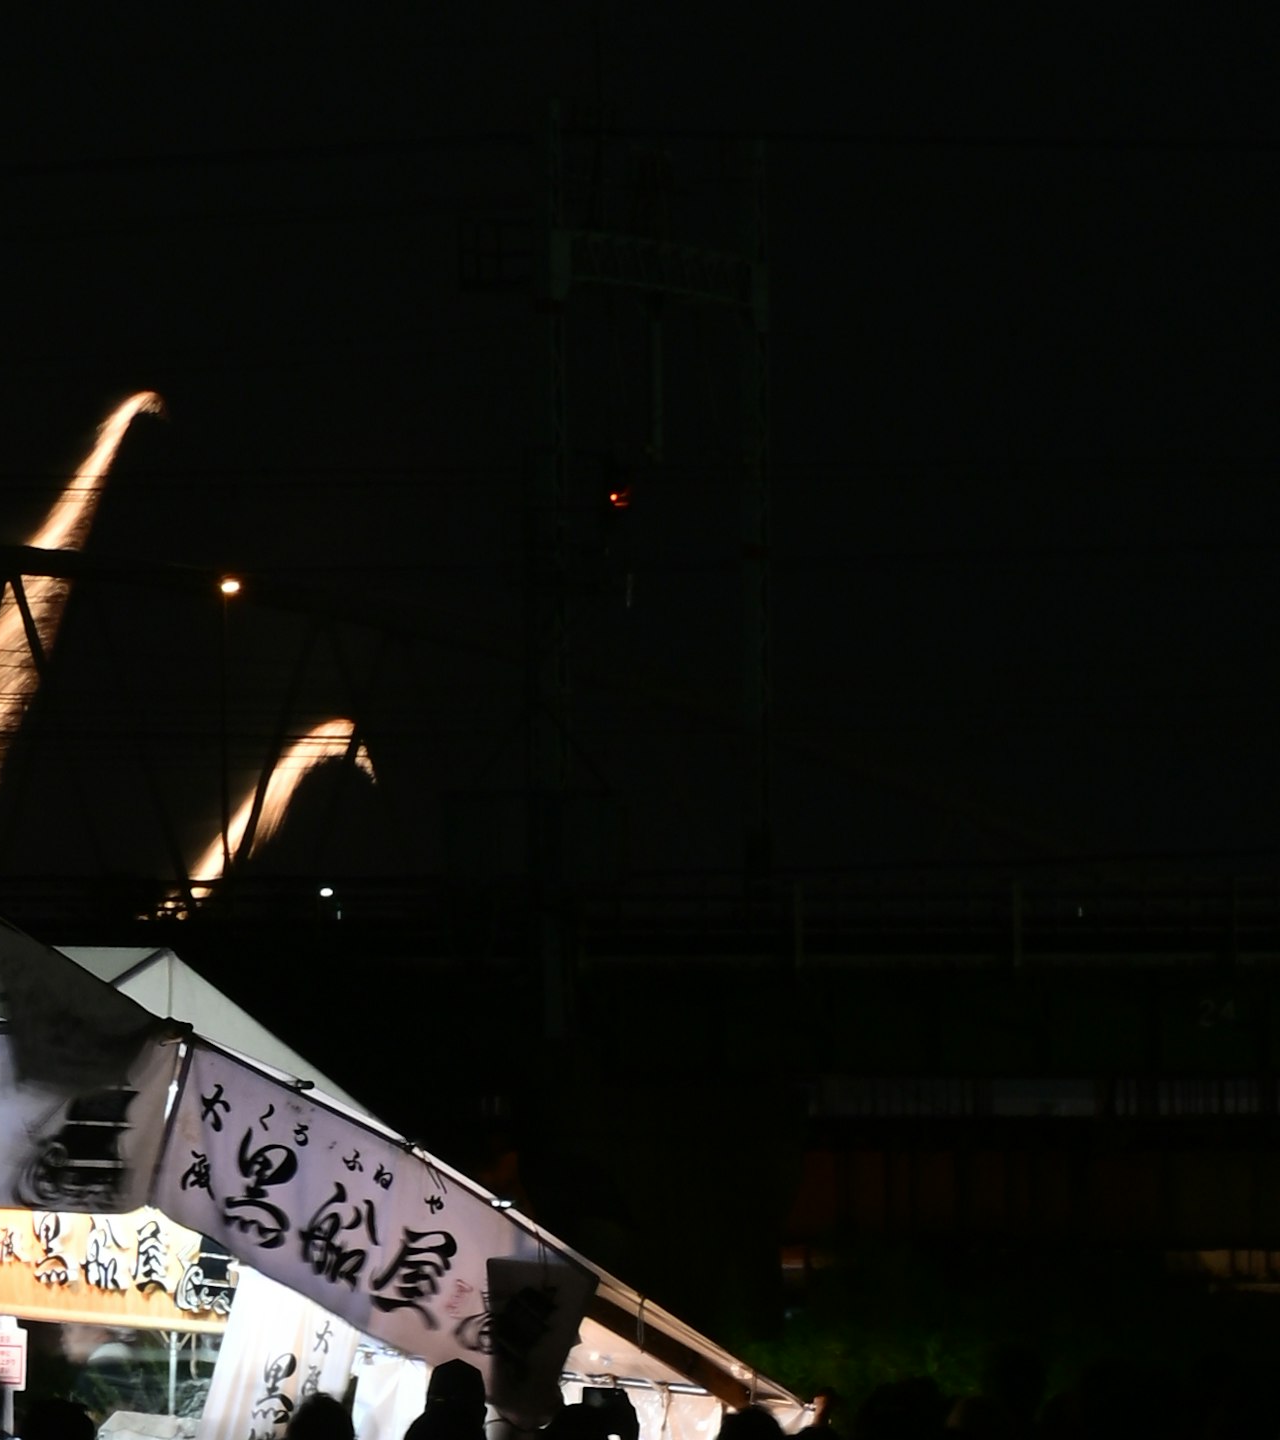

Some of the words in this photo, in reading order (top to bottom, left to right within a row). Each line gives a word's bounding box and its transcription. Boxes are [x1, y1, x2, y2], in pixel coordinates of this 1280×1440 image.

[223, 1127, 458, 1330] 黒船屋
[249, 1351, 297, 1440] 黒
